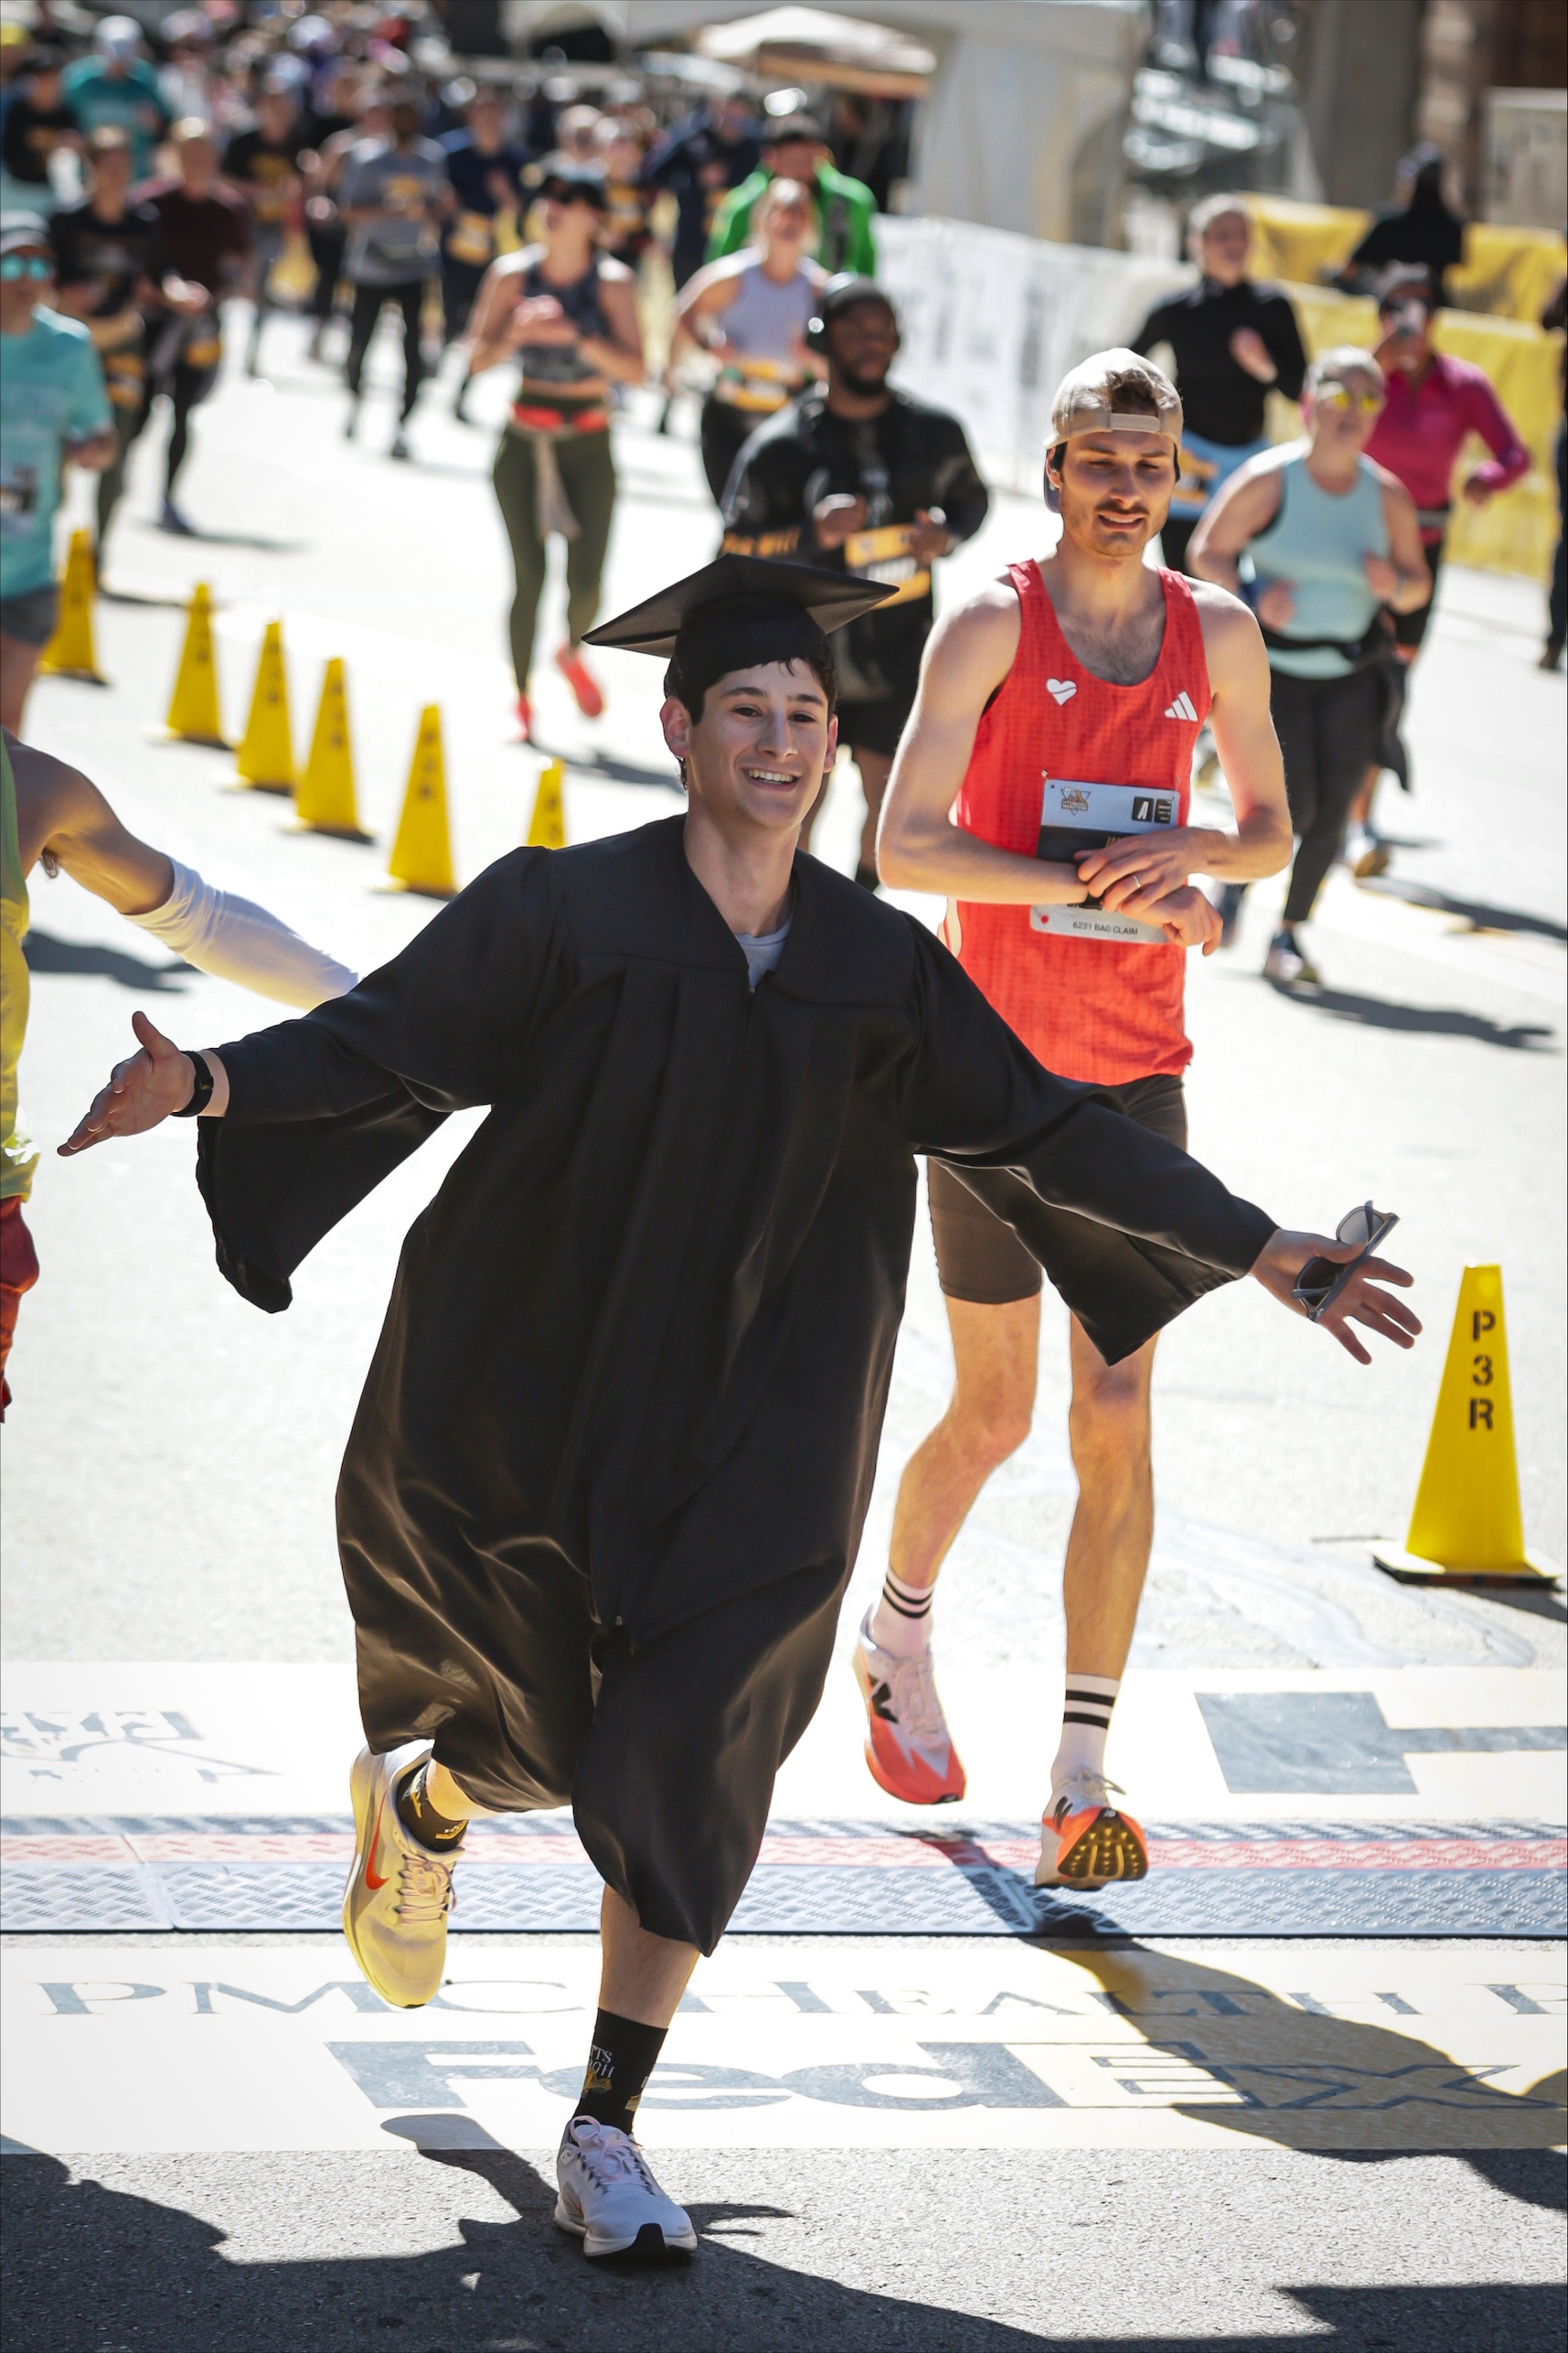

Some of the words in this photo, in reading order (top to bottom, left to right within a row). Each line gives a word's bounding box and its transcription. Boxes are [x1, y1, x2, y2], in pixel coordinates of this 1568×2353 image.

[1137, 801, 1149, 819] A
[1072, 922, 1092, 930] 6231
[1094, 925, 1111, 933] BAG
[1113, 925, 1138, 936] CLAIM
[1469, 1310, 1496, 1430] P3R
